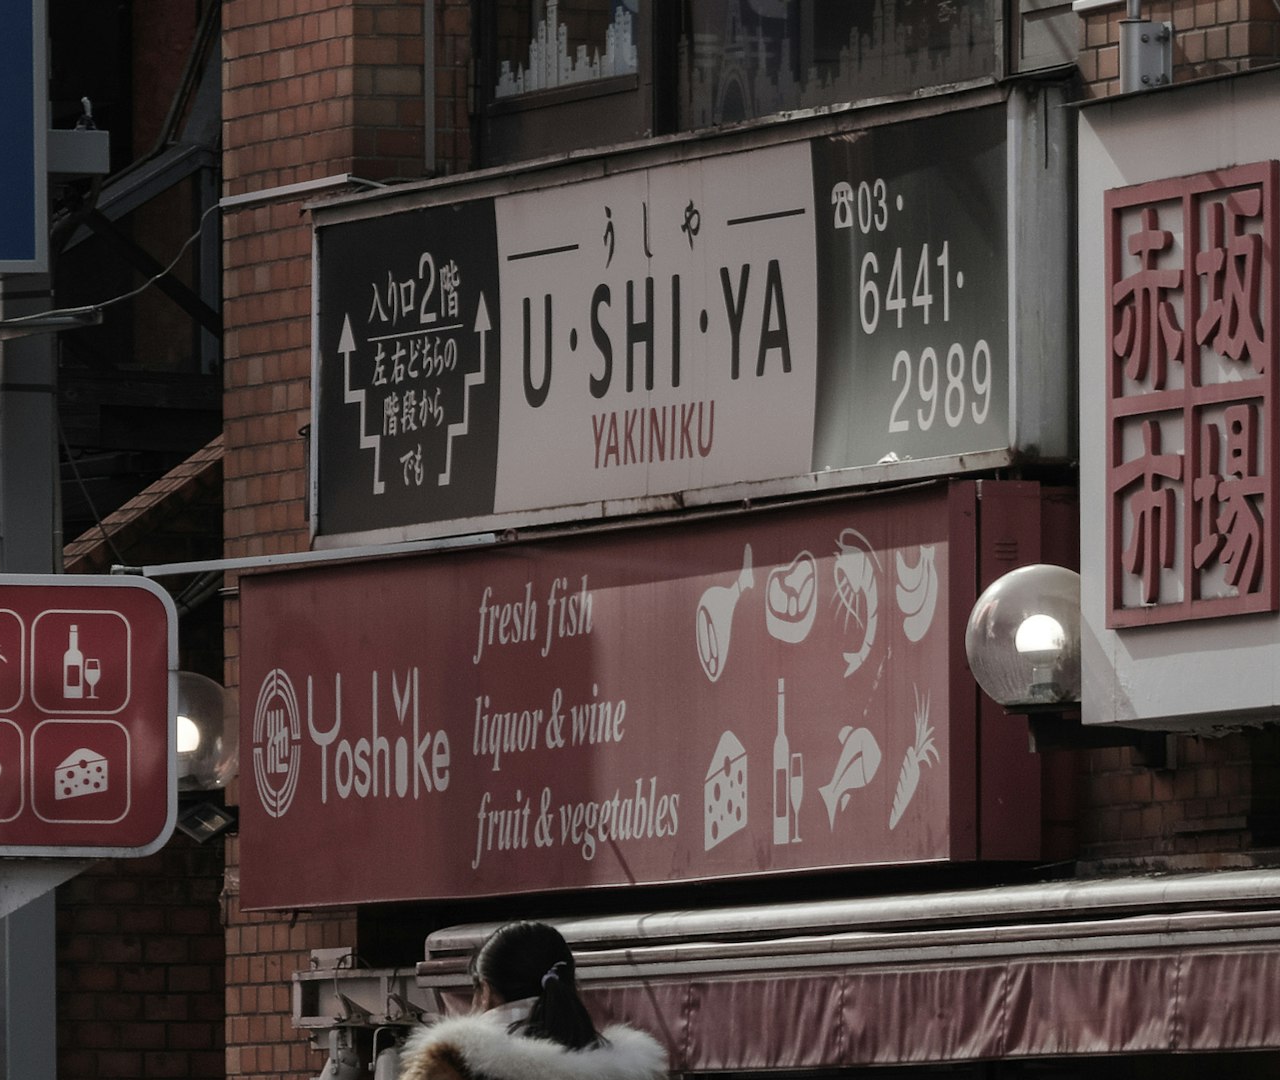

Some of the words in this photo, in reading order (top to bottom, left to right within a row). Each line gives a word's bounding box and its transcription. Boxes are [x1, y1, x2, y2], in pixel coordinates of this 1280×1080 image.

[602, 199, 701, 270] うしや
[368, 251, 461, 328] 入り口2階
[372, 336, 458, 387] 左右どちらの
[888, 338, 993, 434] 2989
[383, 387, 445, 438] 階段から
[591, 399, 715, 470] YAKINIKU
[399, 443, 425, 487] でも
[472, 581, 538, 665] fresh
[540, 573, 594, 658] fish
[472, 694, 543, 772] liquor
[544, 687, 566, 750] &
[569, 682, 627, 747] wine
[471, 791, 531, 870] fruit
[533, 786, 554, 848] &
[558, 775, 681, 861] vegetables
